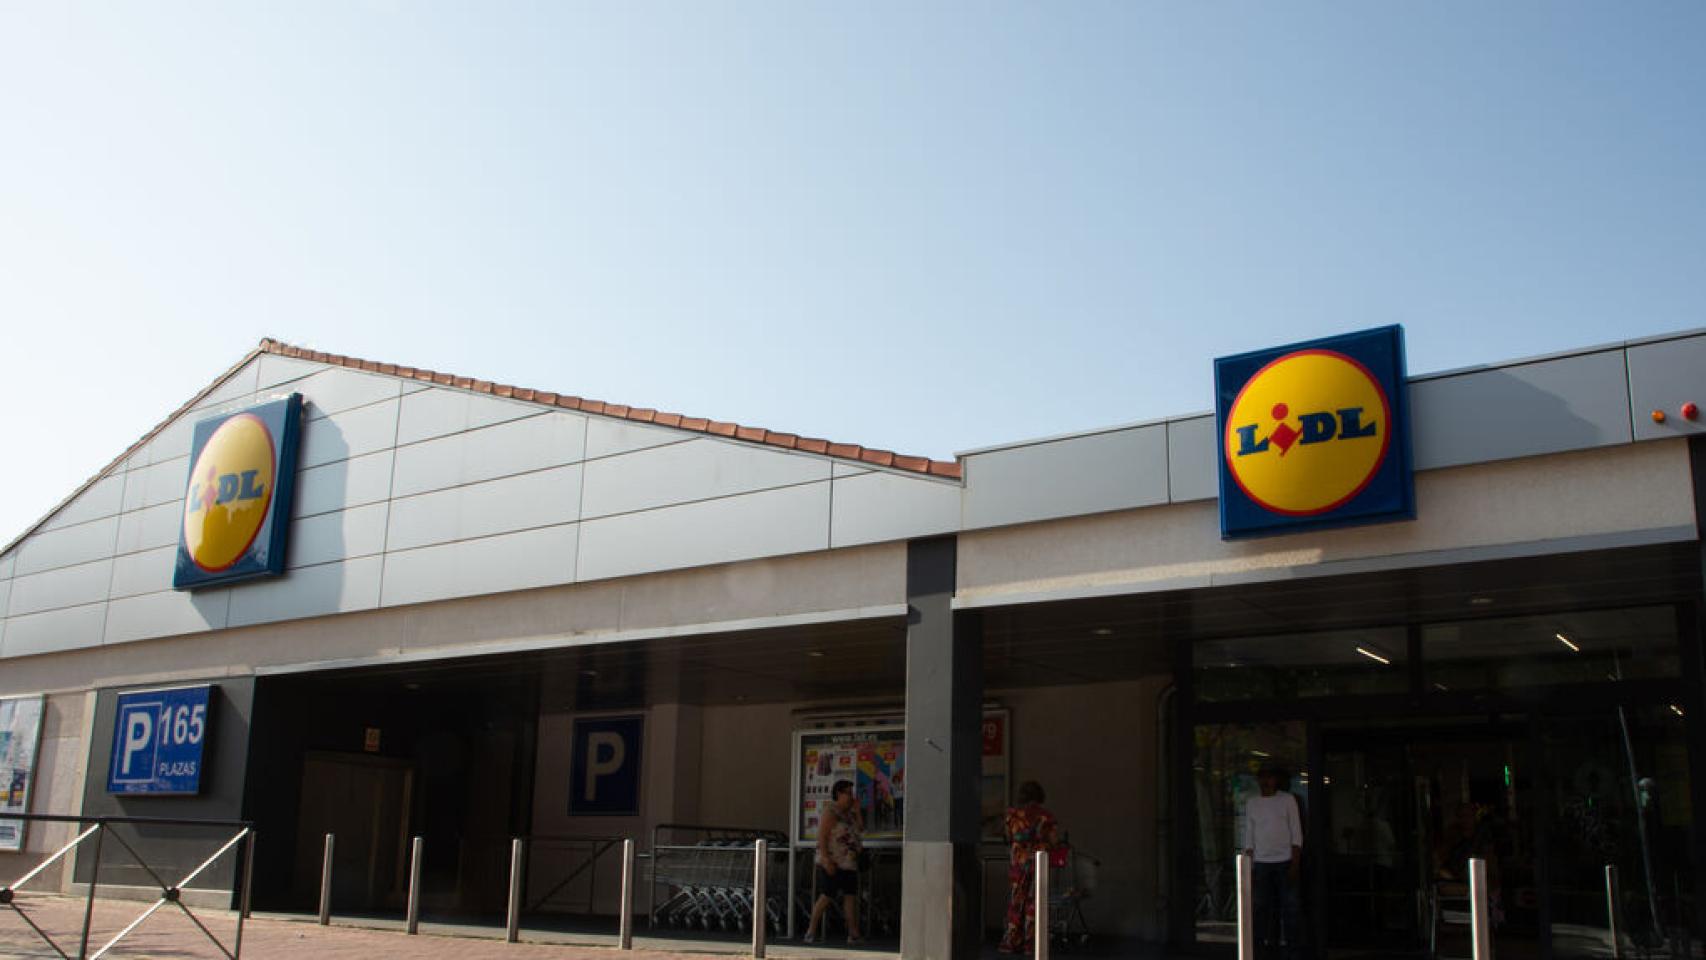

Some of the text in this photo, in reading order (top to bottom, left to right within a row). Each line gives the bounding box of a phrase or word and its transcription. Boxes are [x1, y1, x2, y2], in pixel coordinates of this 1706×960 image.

[122, 712, 152, 774] P
[162, 703, 205, 745] 165
[159, 761, 197, 776] PLAZAS
[584, 731, 626, 801] P
